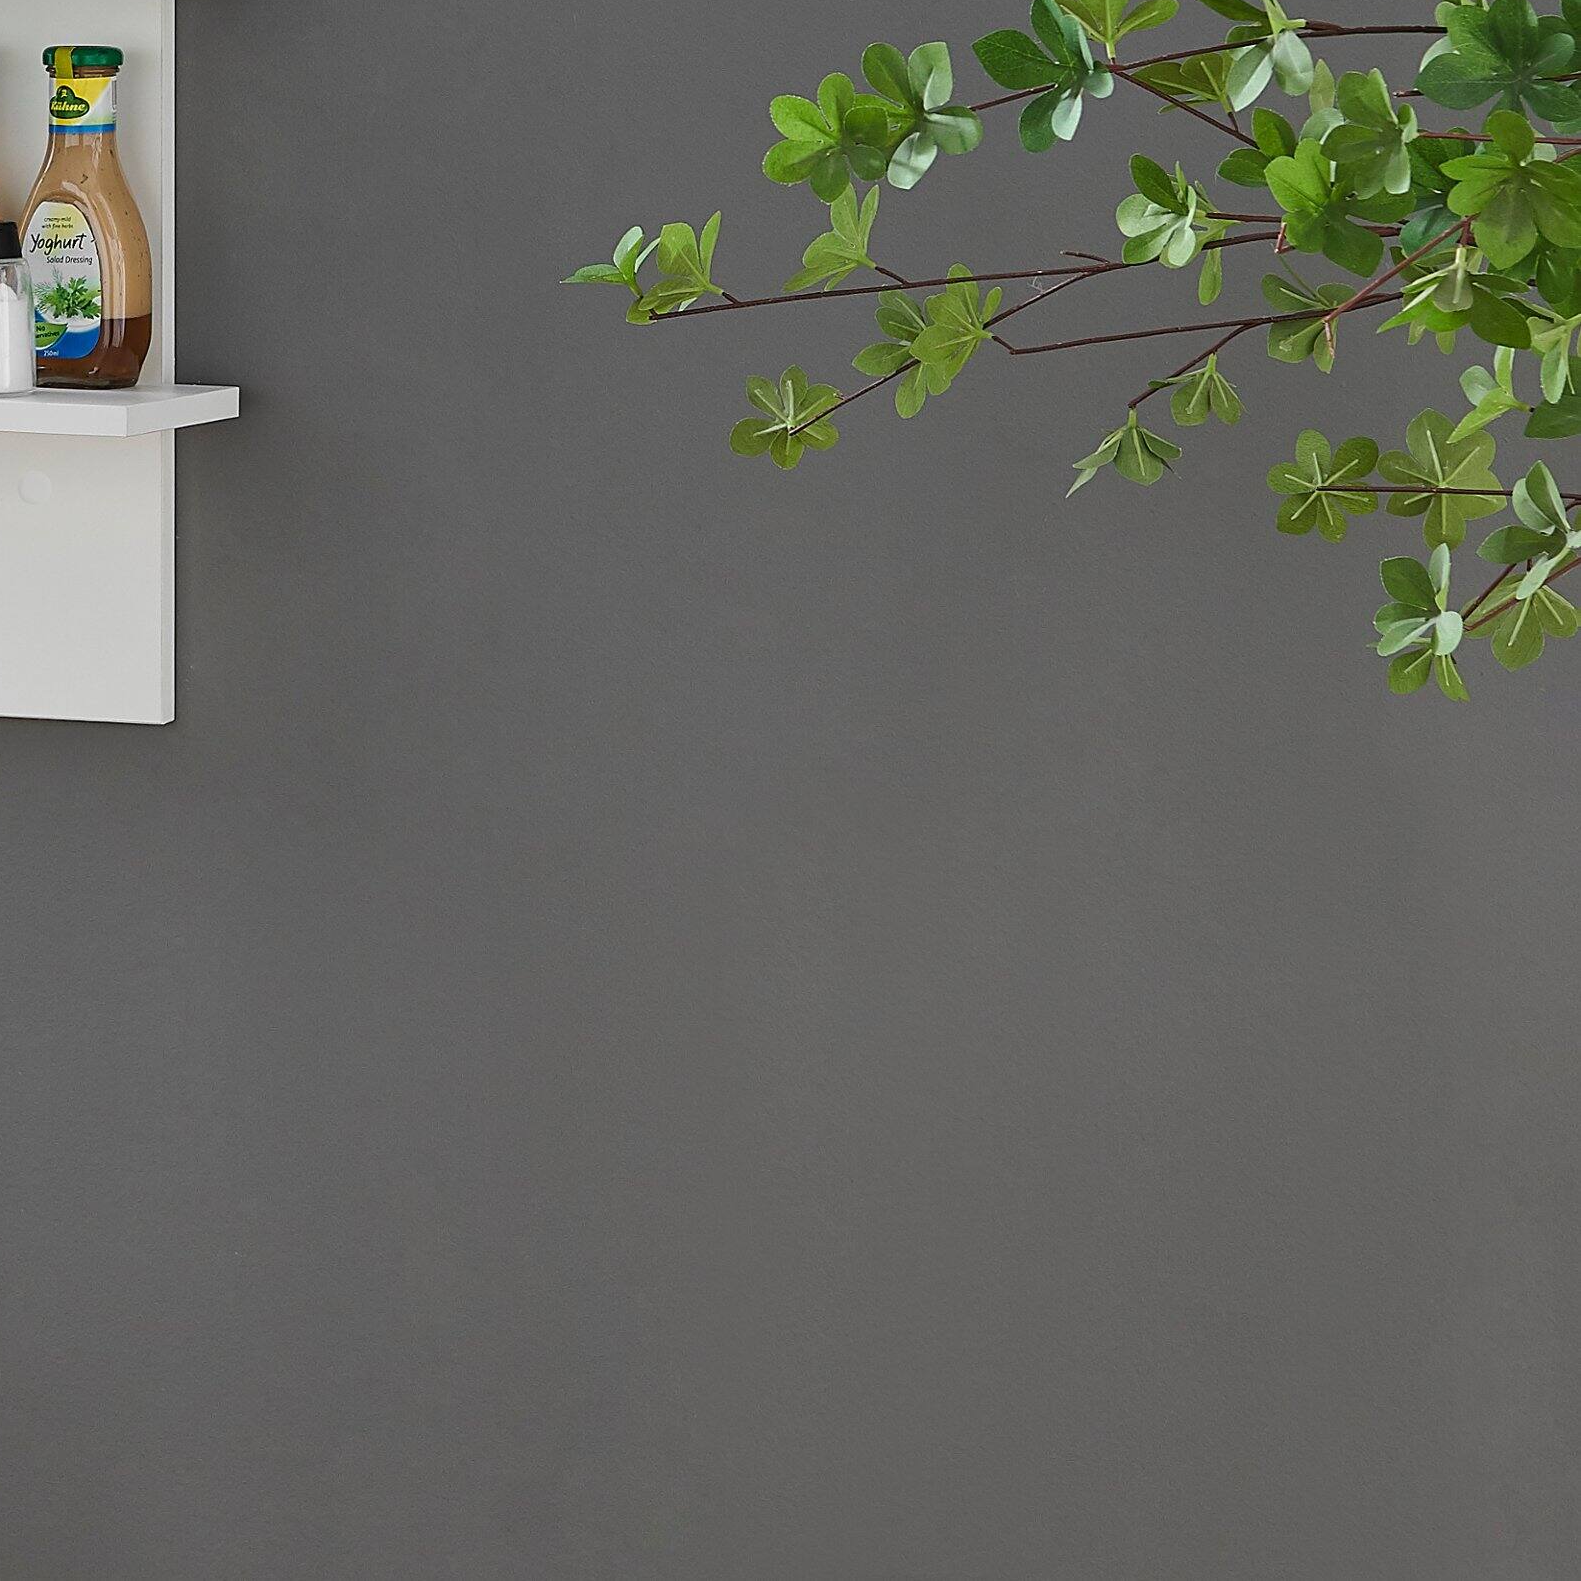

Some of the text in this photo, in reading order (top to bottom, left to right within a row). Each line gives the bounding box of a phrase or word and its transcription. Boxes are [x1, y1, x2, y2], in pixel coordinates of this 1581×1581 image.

[50, 101, 86, 111] Kühne
[29, 233, 87, 256] Yoghurt
[65, 256, 93, 266] Dressing
